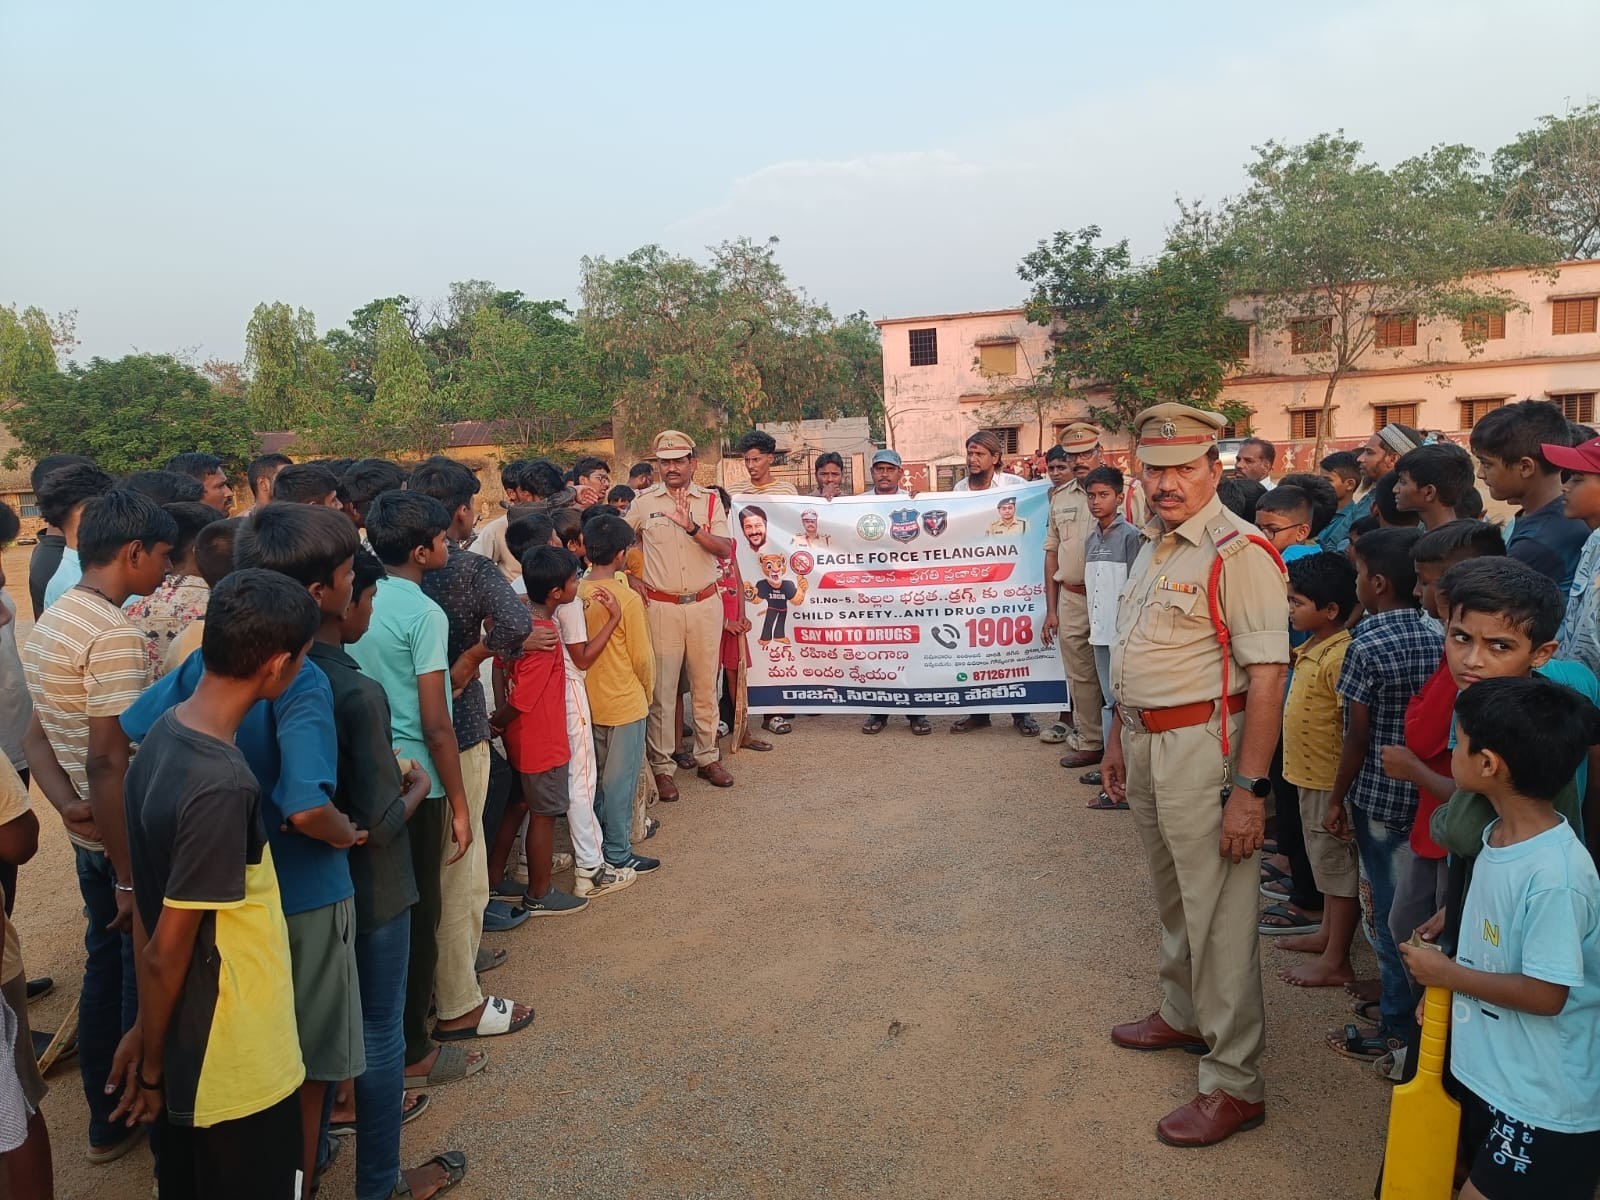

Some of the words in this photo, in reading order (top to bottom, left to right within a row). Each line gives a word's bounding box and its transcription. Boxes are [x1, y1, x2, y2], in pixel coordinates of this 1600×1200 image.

[816, 553, 864, 565] EAGLE
[869, 551, 919, 563] FORCE
[922, 545, 1018, 560] TELANGANA
[835, 571, 896, 586] ప్రజాపాలన
[909, 569, 939, 583] ప్రగతి
[943, 566, 991, 581] ప్రణాళిక
[858, 593, 894, 608] పిల్లల
[982, 587, 998, 599] కు
[793, 611, 834, 620] CHILD
[944, 606, 986, 616] DRUG
[991, 603, 1035, 614] DRIVE
[801, 629, 822, 641] SAY
[825, 629, 842, 642] NO
[846, 629, 863, 641] TO
[866, 627, 912, 641] DRUGS
[965, 615, 1033, 648] 1908
[800, 647, 838, 660] రహిత
[843, 648, 909, 660] తెలంగాణ
[768, 665, 798, 678] మన
[803, 665, 844, 678] అందరి
[973, 666, 1030, 681] 8712671111
[782, 688, 846, 703] రాజన్న
[847, 689, 910, 705] సిరిసిల్ల
[914, 692, 960, 705] జిల్లా
[964, 683, 1027, 700] పోలీస్
[1483, 918, 1499, 948] N
